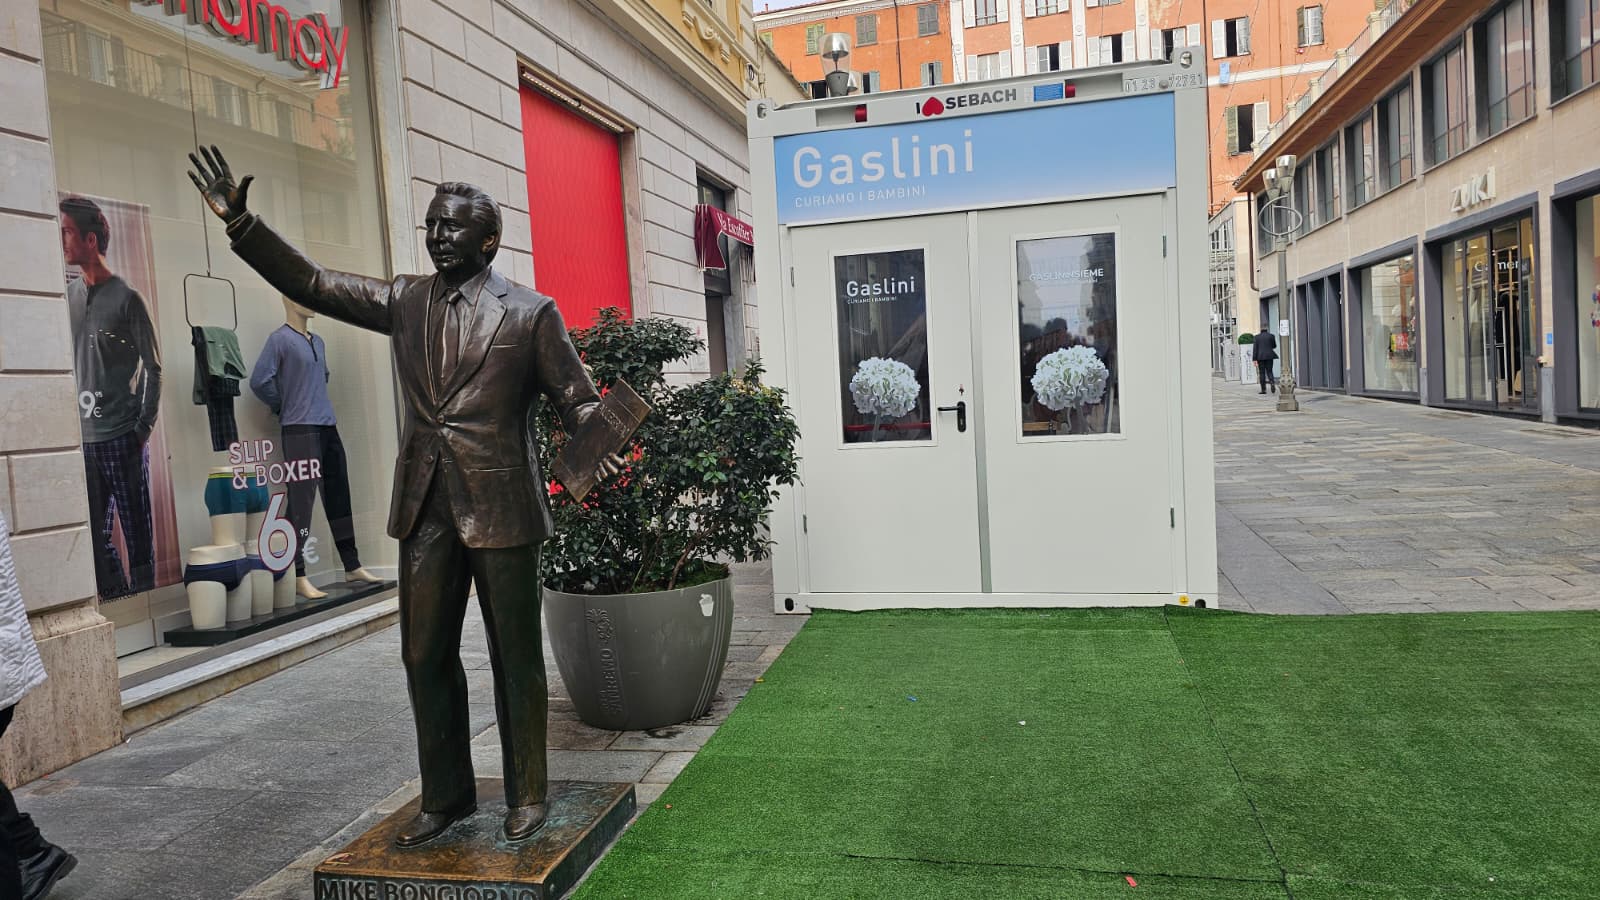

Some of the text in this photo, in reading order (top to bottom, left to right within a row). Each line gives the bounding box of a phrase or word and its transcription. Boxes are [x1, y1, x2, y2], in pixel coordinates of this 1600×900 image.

[154, 0, 348, 88] amay
[945, 88, 1017, 110] SEBACH
[793, 129, 973, 188] Gaslini
[795, 192, 854, 208] CURIAMO
[868, 184, 926, 201] BAMBINI
[1450, 166, 1497, 212] ZUIKI
[846, 276, 915, 297] Gaslini
[229, 439, 274, 464] SLIP
[232, 458, 322, 490] & BOXER
[258, 492, 297, 572] 6
[302, 536, 319, 564] €
[317, 879, 538, 900] MIKE BONGIORNO
